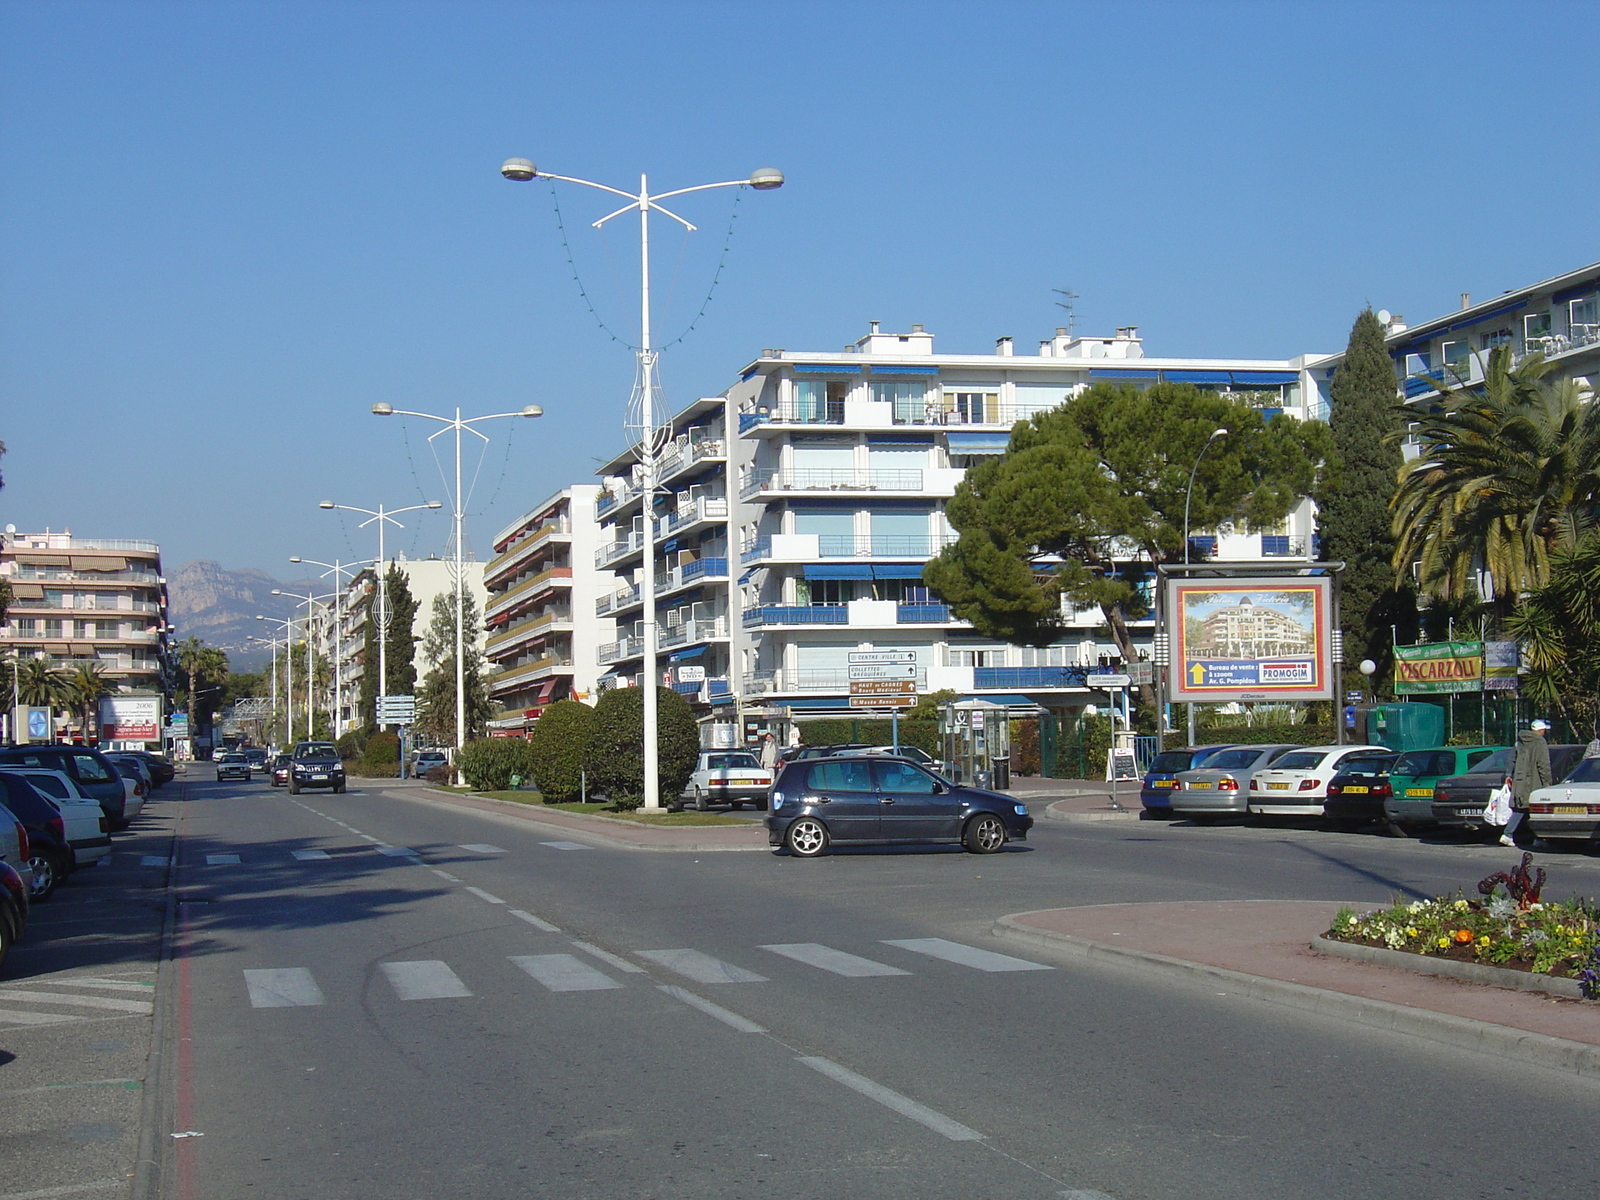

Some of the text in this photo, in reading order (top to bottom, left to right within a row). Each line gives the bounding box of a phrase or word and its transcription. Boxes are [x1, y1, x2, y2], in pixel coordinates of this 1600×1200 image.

[1263, 669, 1308, 678] PROMOGIM
[1400, 660, 1475, 679] PESCARZOLI
[1226, 677, 1256, 685] Pompidou
